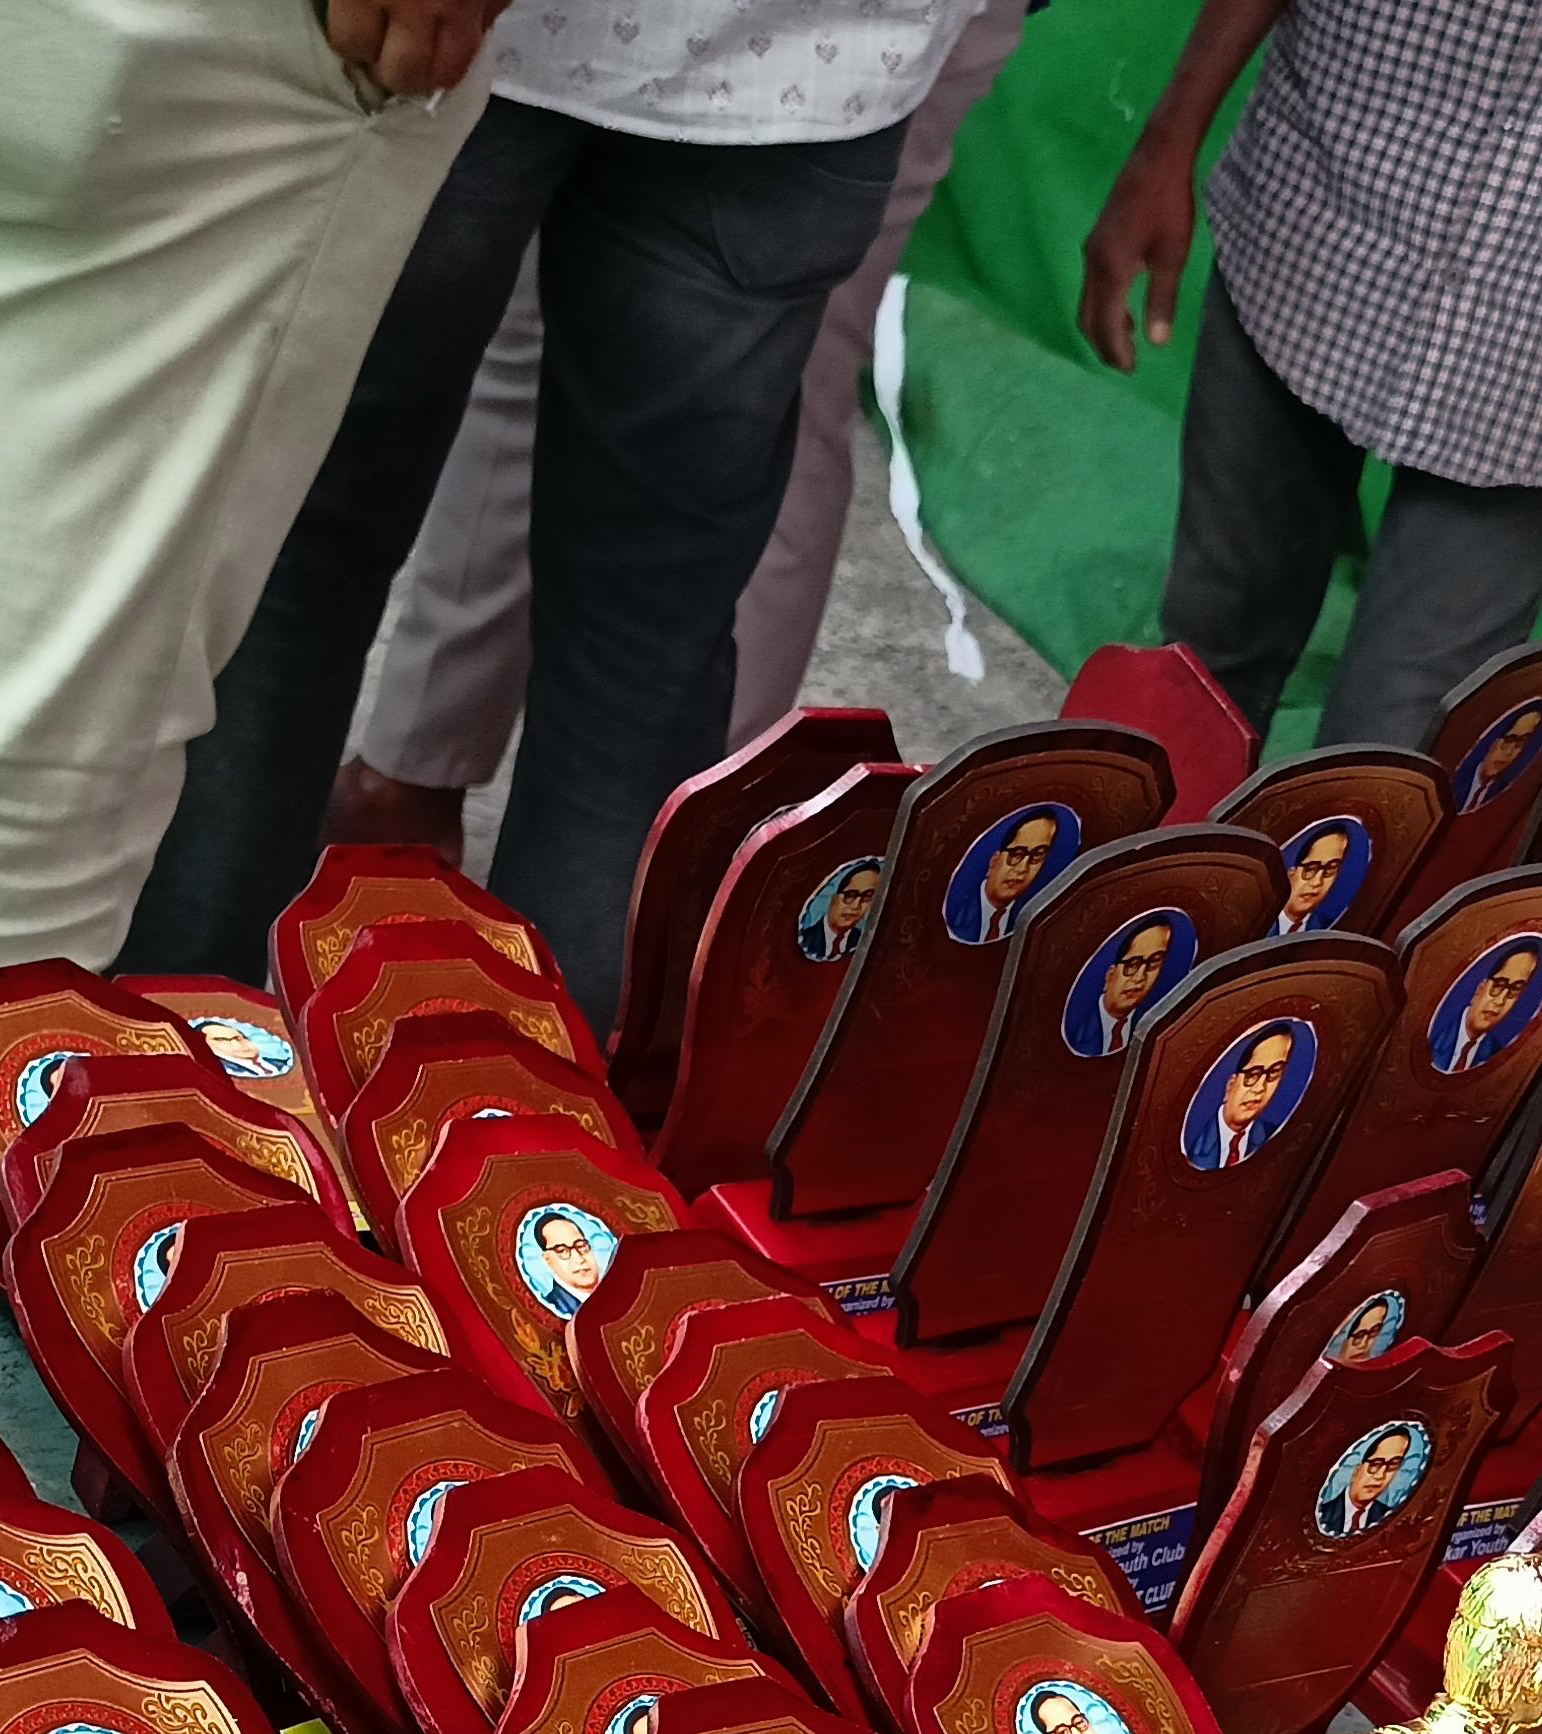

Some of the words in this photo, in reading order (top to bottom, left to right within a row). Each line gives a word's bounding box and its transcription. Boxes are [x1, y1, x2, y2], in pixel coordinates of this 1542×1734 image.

[855, 1281, 879, 1296] THE
[1470, 1508, 1493, 1525] THE
[1493, 1504, 1520, 1520] MAT
[1105, 1526, 1129, 1545] THE
[1129, 1516, 1171, 1539] MATCH
[1131, 1541, 1145, 1554] by
[1151, 1543, 1187, 1567] Club
